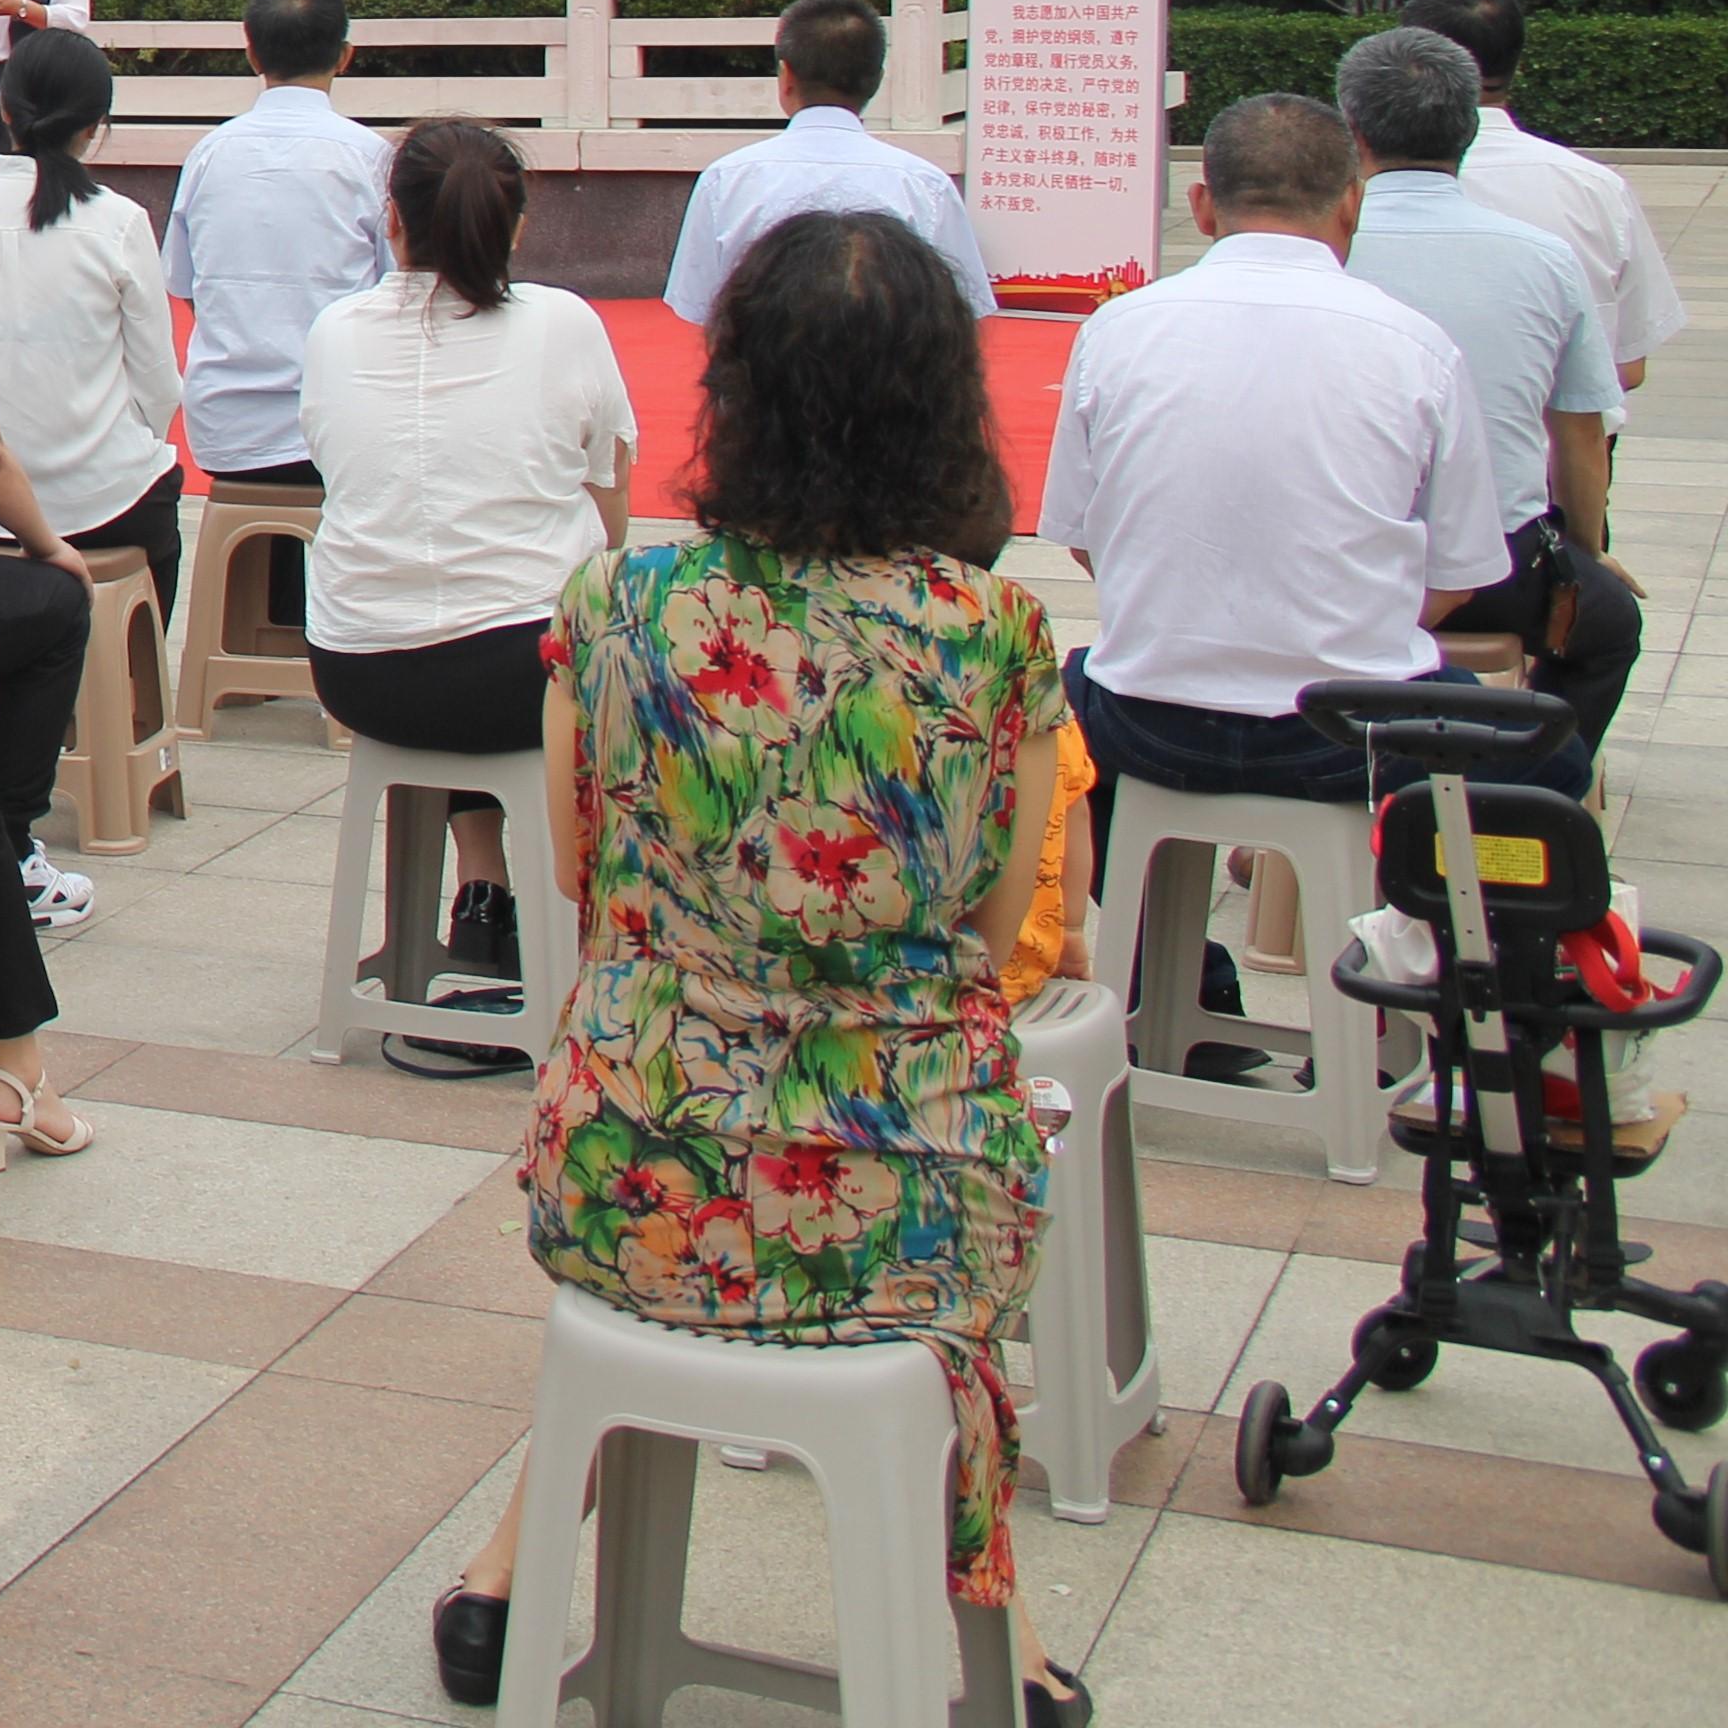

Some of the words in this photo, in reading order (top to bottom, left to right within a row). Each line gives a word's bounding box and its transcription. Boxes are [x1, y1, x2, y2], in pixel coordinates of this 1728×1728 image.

[1012, 4, 1139, 21] 我志愿加入中国共产
